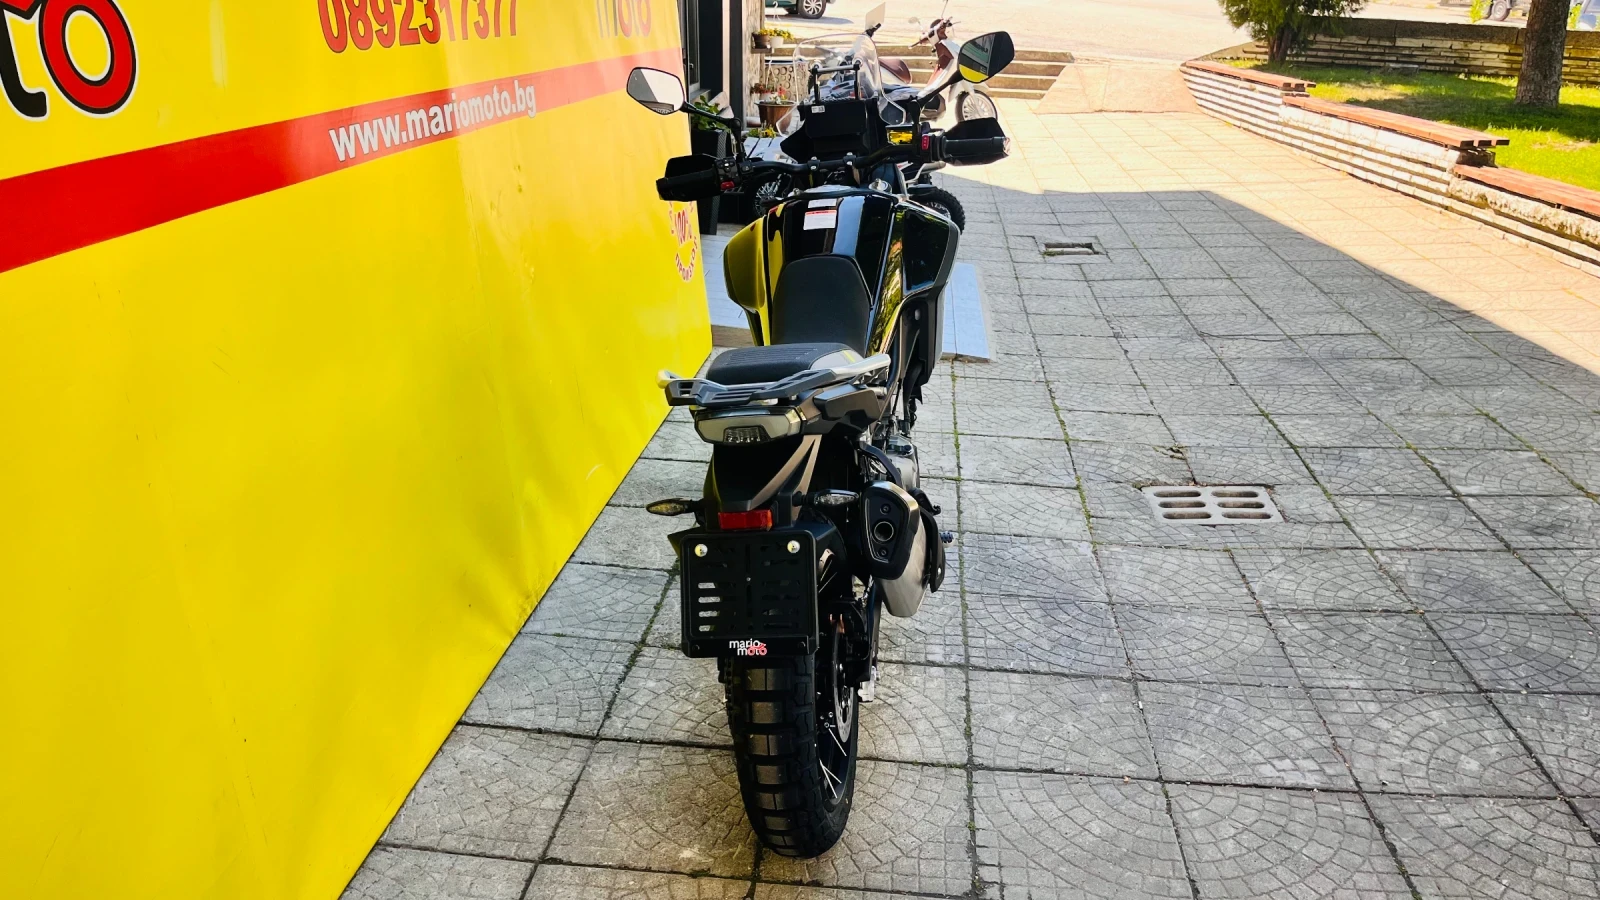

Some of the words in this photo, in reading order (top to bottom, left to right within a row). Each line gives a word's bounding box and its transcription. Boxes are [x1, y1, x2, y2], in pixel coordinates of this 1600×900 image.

[329, 79, 537, 162] www.mariomoto.bg
[729, 637, 761, 648] mario
[737, 645, 767, 656] moto
